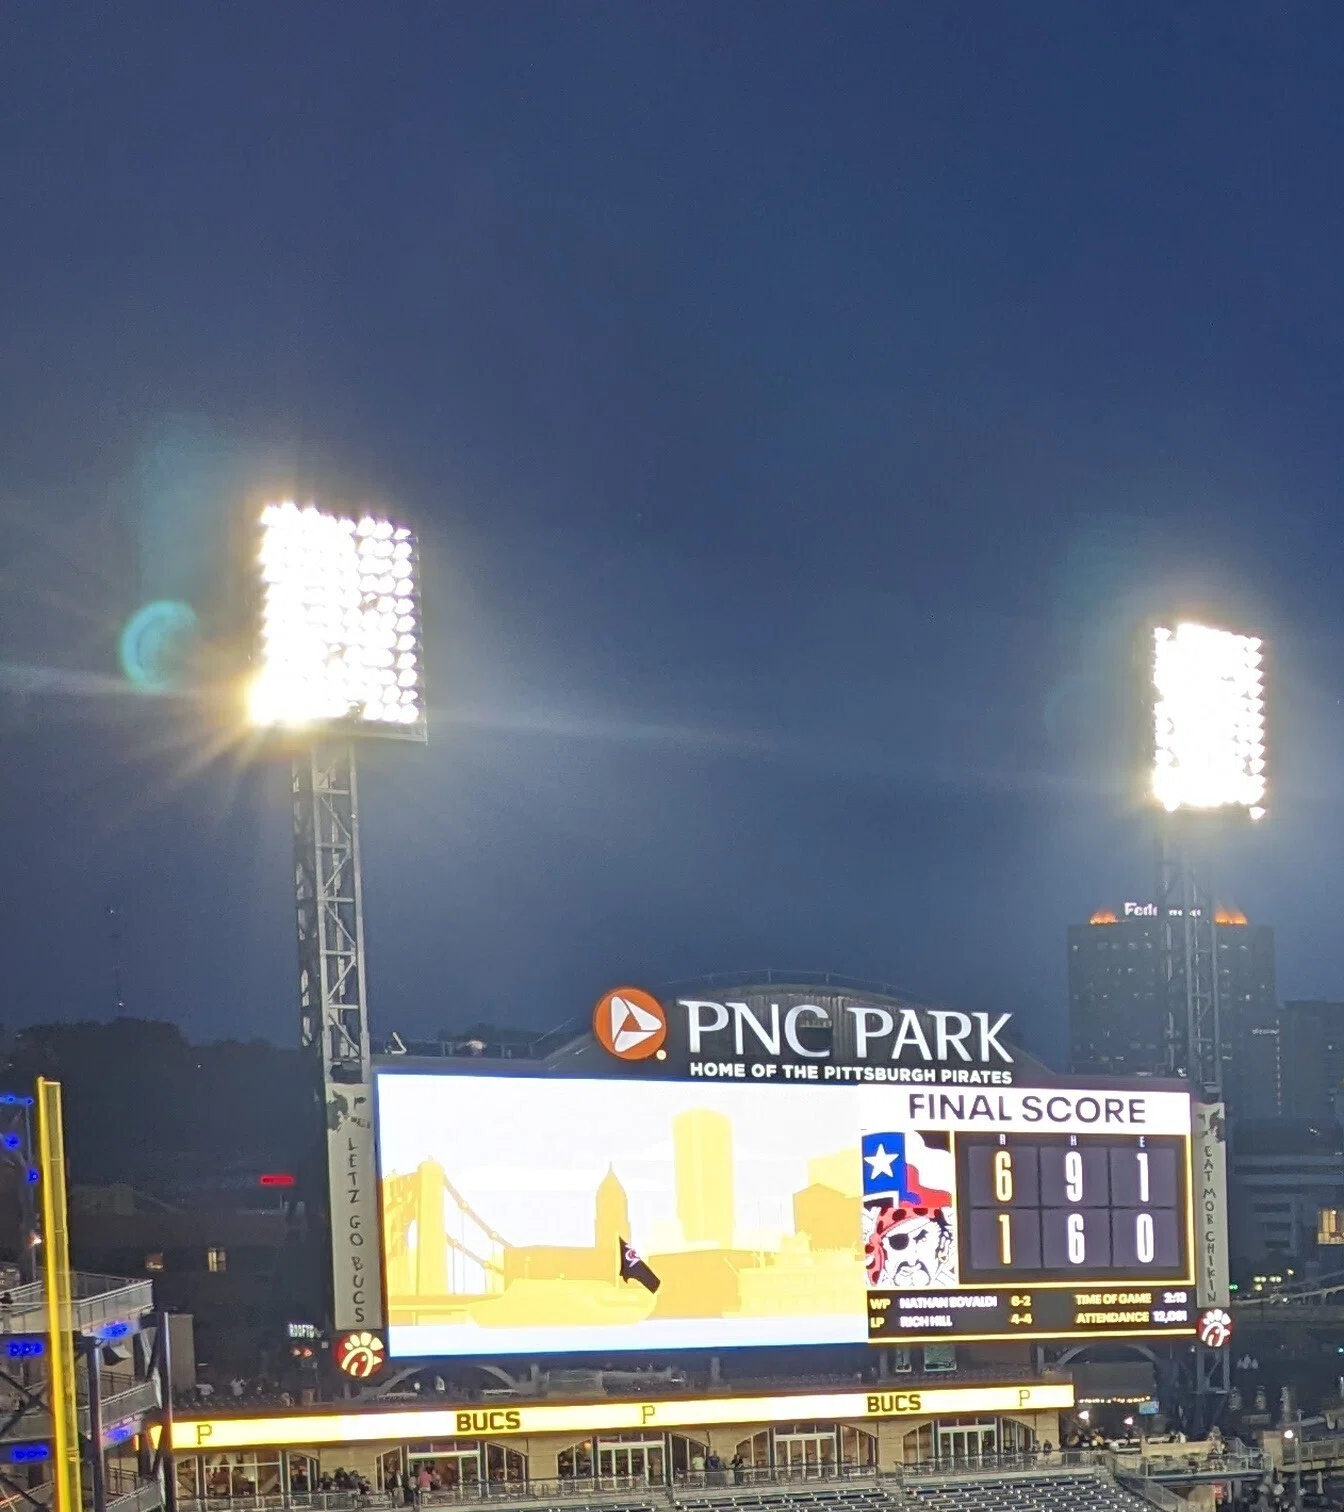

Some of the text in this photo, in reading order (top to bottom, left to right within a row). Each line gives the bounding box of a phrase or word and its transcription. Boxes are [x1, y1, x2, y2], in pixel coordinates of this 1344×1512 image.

[678, 999, 1015, 1063] PNC PARK
[690, 1061, 1013, 1085] HOME OF THE PITTSBURGH PIRATES
[909, 1094, 1146, 1123] FINAL SCORE
[1204, 1146, 1214, 1182] EAT
[995, 1151, 1149, 1202] 6 9 1
[347, 1136, 365, 1323] LETZ GO BUCS
[998, 1213, 1154, 1264] 1 6 0
[870, 1297, 891, 1310] WP
[1075, 1293, 1152, 1307] TIME OF GAME
[870, 1312, 1032, 1328] LP RICH HILL 4-4
[1075, 1311, 1150, 1324] ATTENDANCE
[866, 1393, 923, 1415] BUCS
[1019, 1389, 1031, 1407] P
[456, 1410, 521, 1434] BUCS
[642, 1406, 656, 1426] P
[196, 1424, 213, 1444] P
